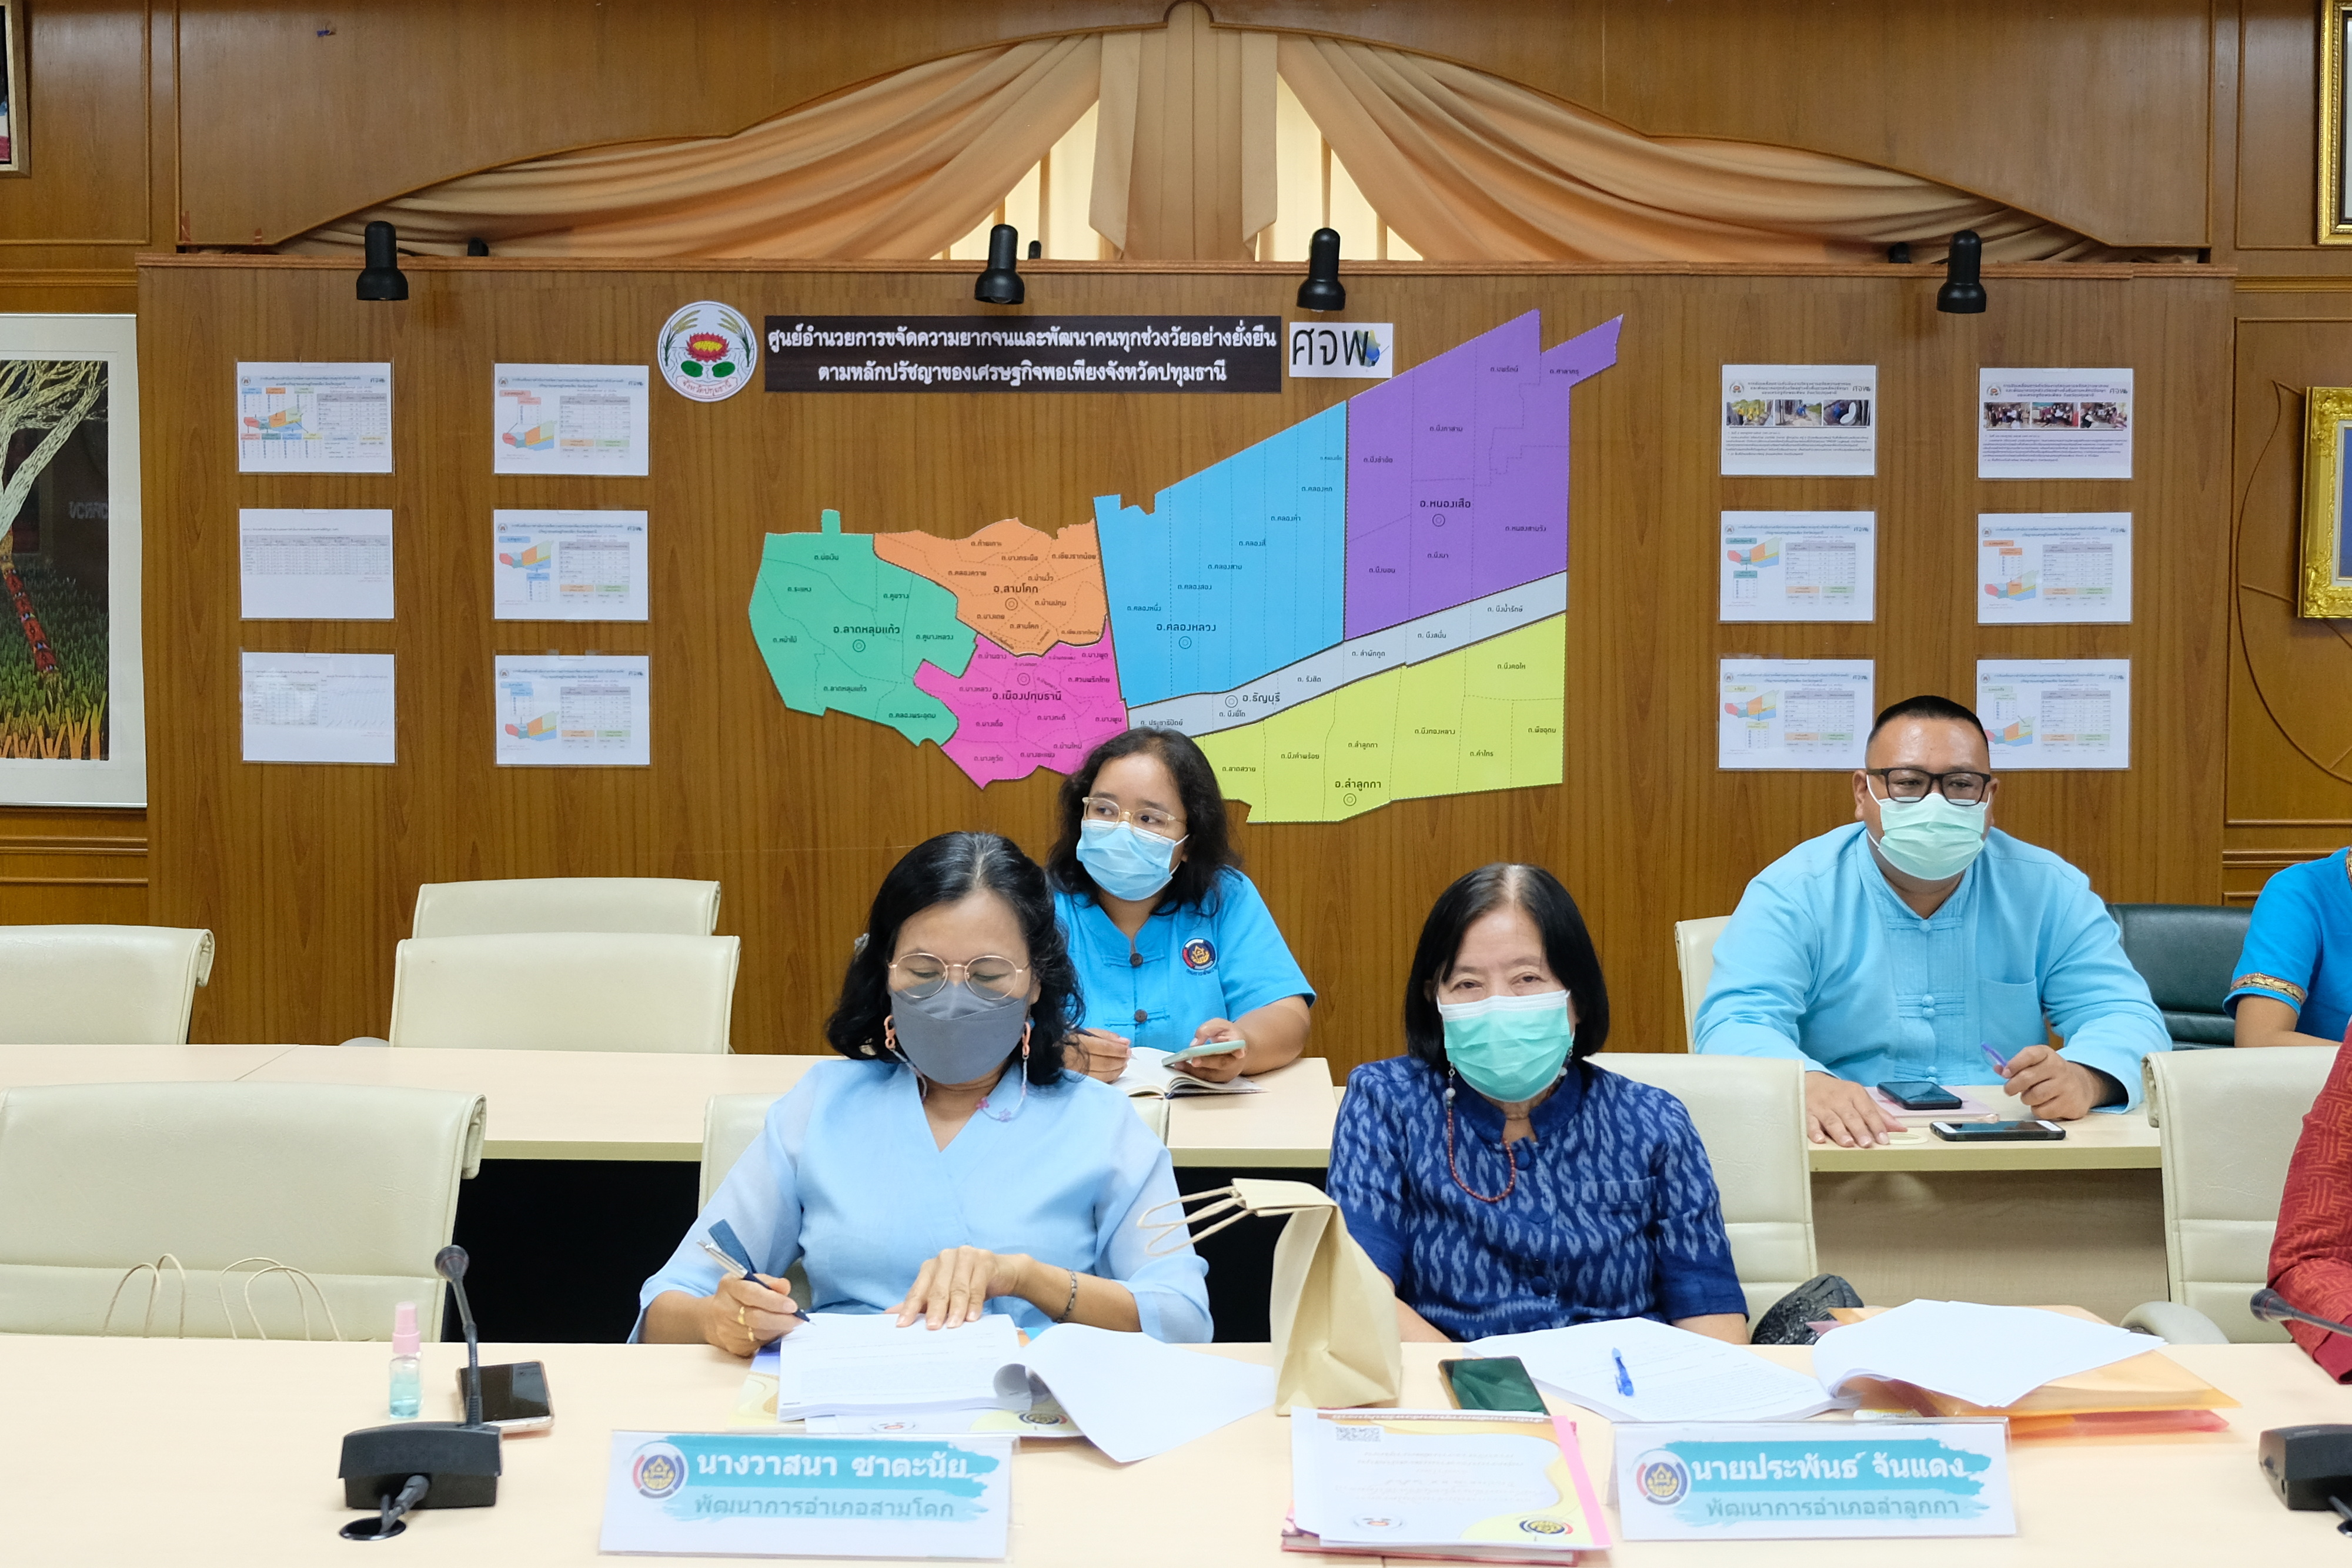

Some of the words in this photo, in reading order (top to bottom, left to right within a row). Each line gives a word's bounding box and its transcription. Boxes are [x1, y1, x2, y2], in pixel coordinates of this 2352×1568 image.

[1292, 328, 1369, 366] ศจพ
[1419, 497, 1471, 509] อ.หนองเสือ
[993, 582, 1038, 594] อ.สามโคก
[833, 623, 900, 637] อ.ลาดหลุมแก้ว
[1156, 623, 1217, 632] อ.คลองหลวง
[992, 690, 1062, 703] อ.เมืองปทุมธานี
[1242, 691, 1281, 705] อ.ธัญบุรี
[1335, 777, 1381, 792] อ.ลำลูกกา
[1872, 1451, 1967, 1479] จันแดง
